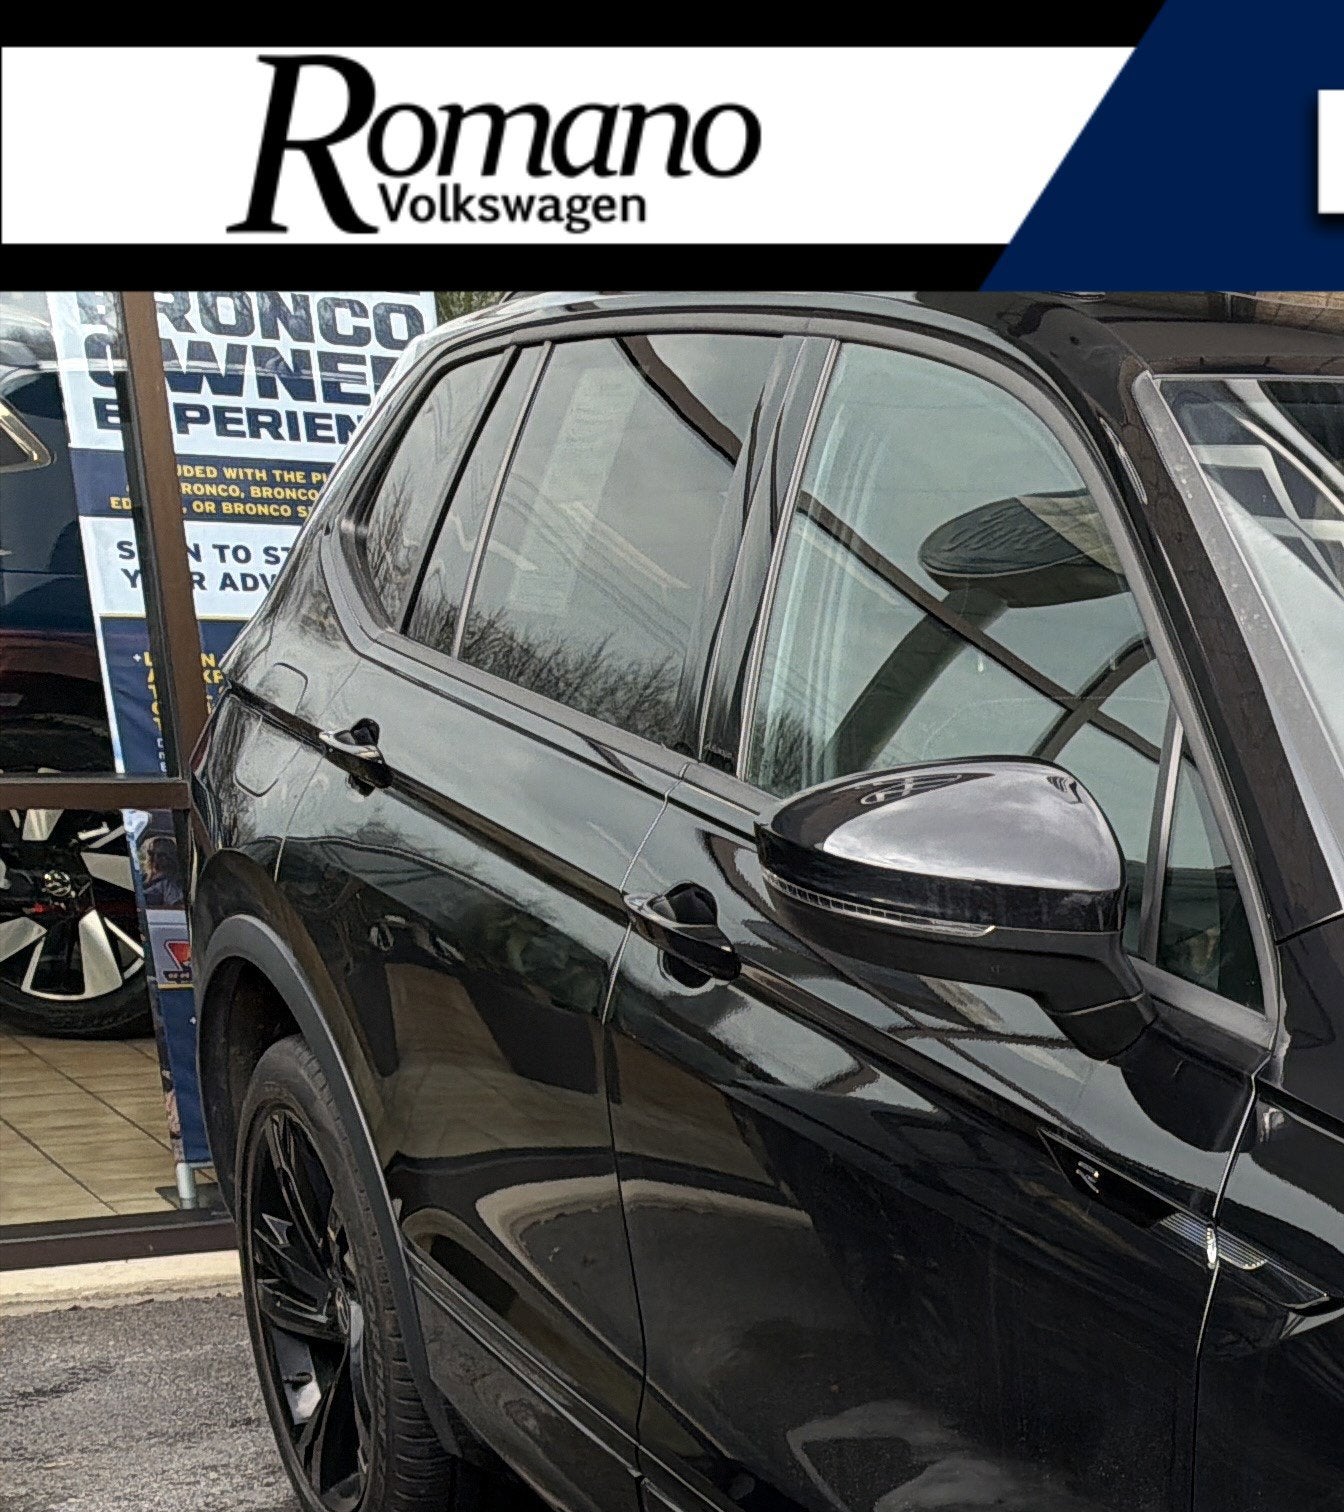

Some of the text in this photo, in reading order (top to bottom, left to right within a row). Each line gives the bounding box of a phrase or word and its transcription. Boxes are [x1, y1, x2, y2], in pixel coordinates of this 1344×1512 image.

[222, 467, 267, 482] WITH
[272, 470, 307, 484] THE
[181, 482, 319, 501] RONCO, BRONCO
[192, 500, 216, 514] OR
[222, 502, 292, 517] BRONCO
[212, 544, 252, 564] TO
